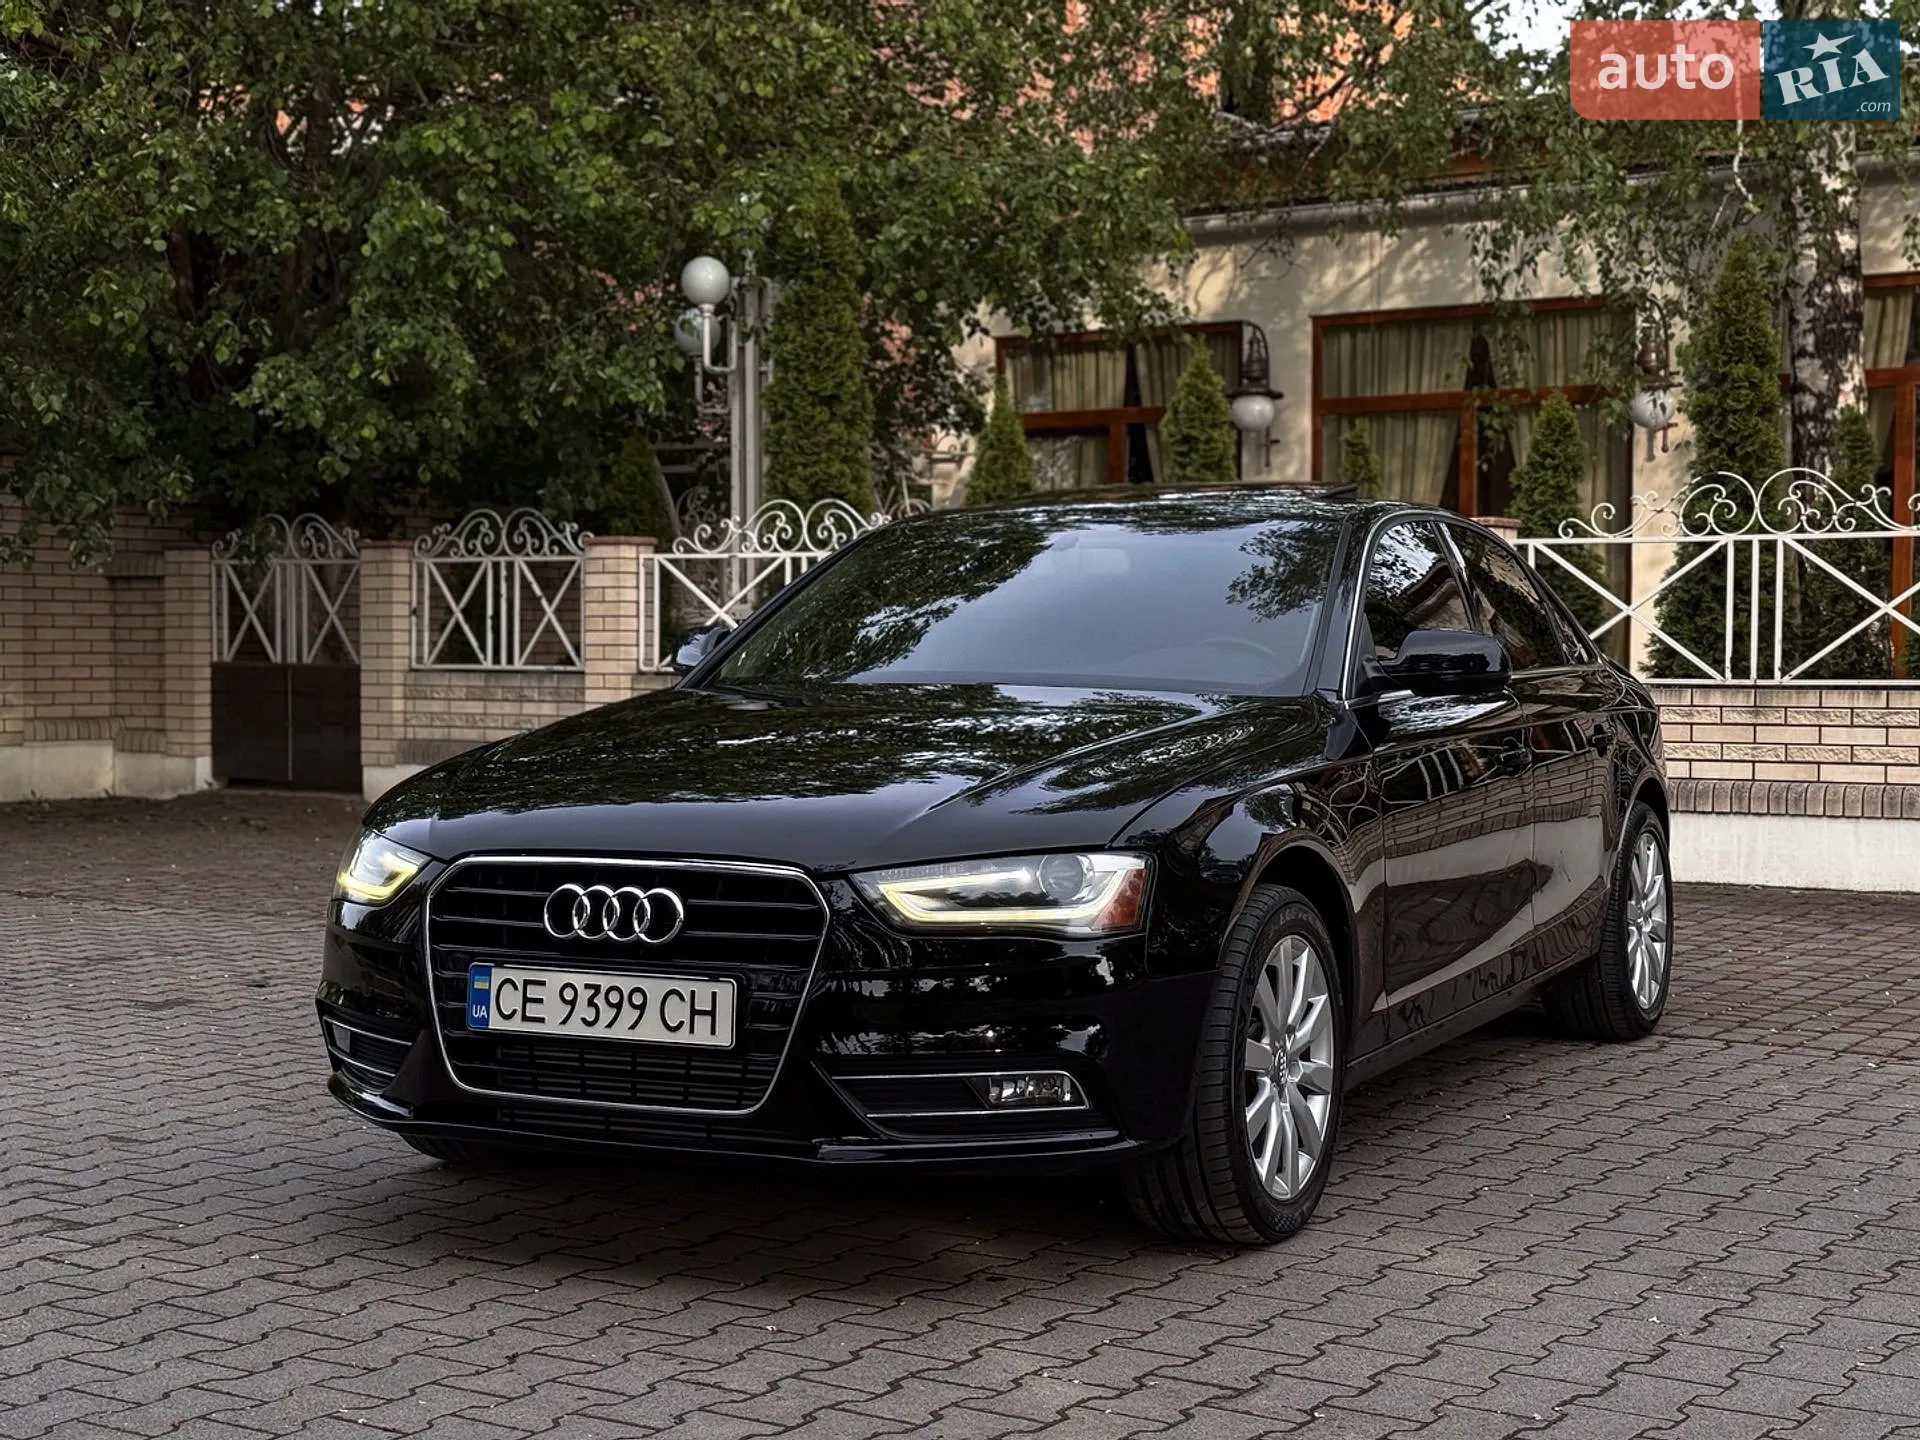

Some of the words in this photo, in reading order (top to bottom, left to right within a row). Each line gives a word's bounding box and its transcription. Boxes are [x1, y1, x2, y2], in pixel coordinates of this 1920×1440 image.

[472, 1004, 488, 1019] UA
[495, 978, 547, 1024] CE
[558, 982, 648, 1030] 9399
[659, 988, 717, 1036] CH
